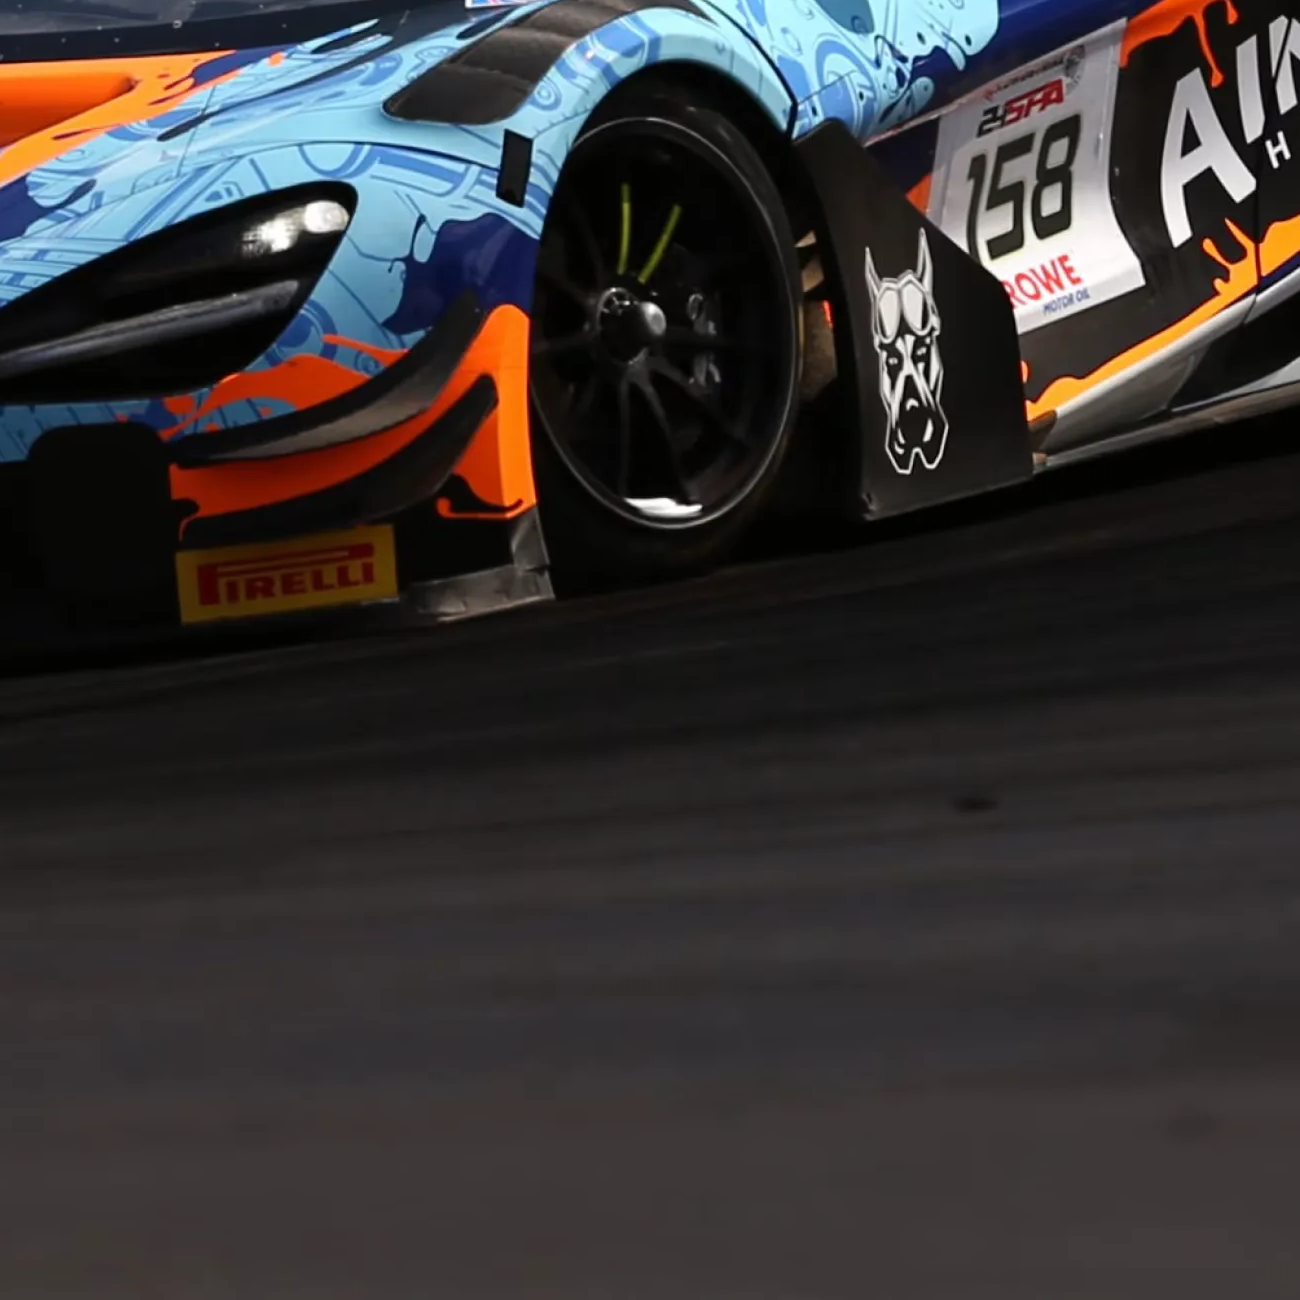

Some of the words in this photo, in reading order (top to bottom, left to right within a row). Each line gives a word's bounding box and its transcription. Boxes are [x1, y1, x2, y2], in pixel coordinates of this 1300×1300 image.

[966, 112, 1081, 260] 158
[1003, 254, 1085, 310] ROWE
[196, 542, 375, 606] PIRELLI
